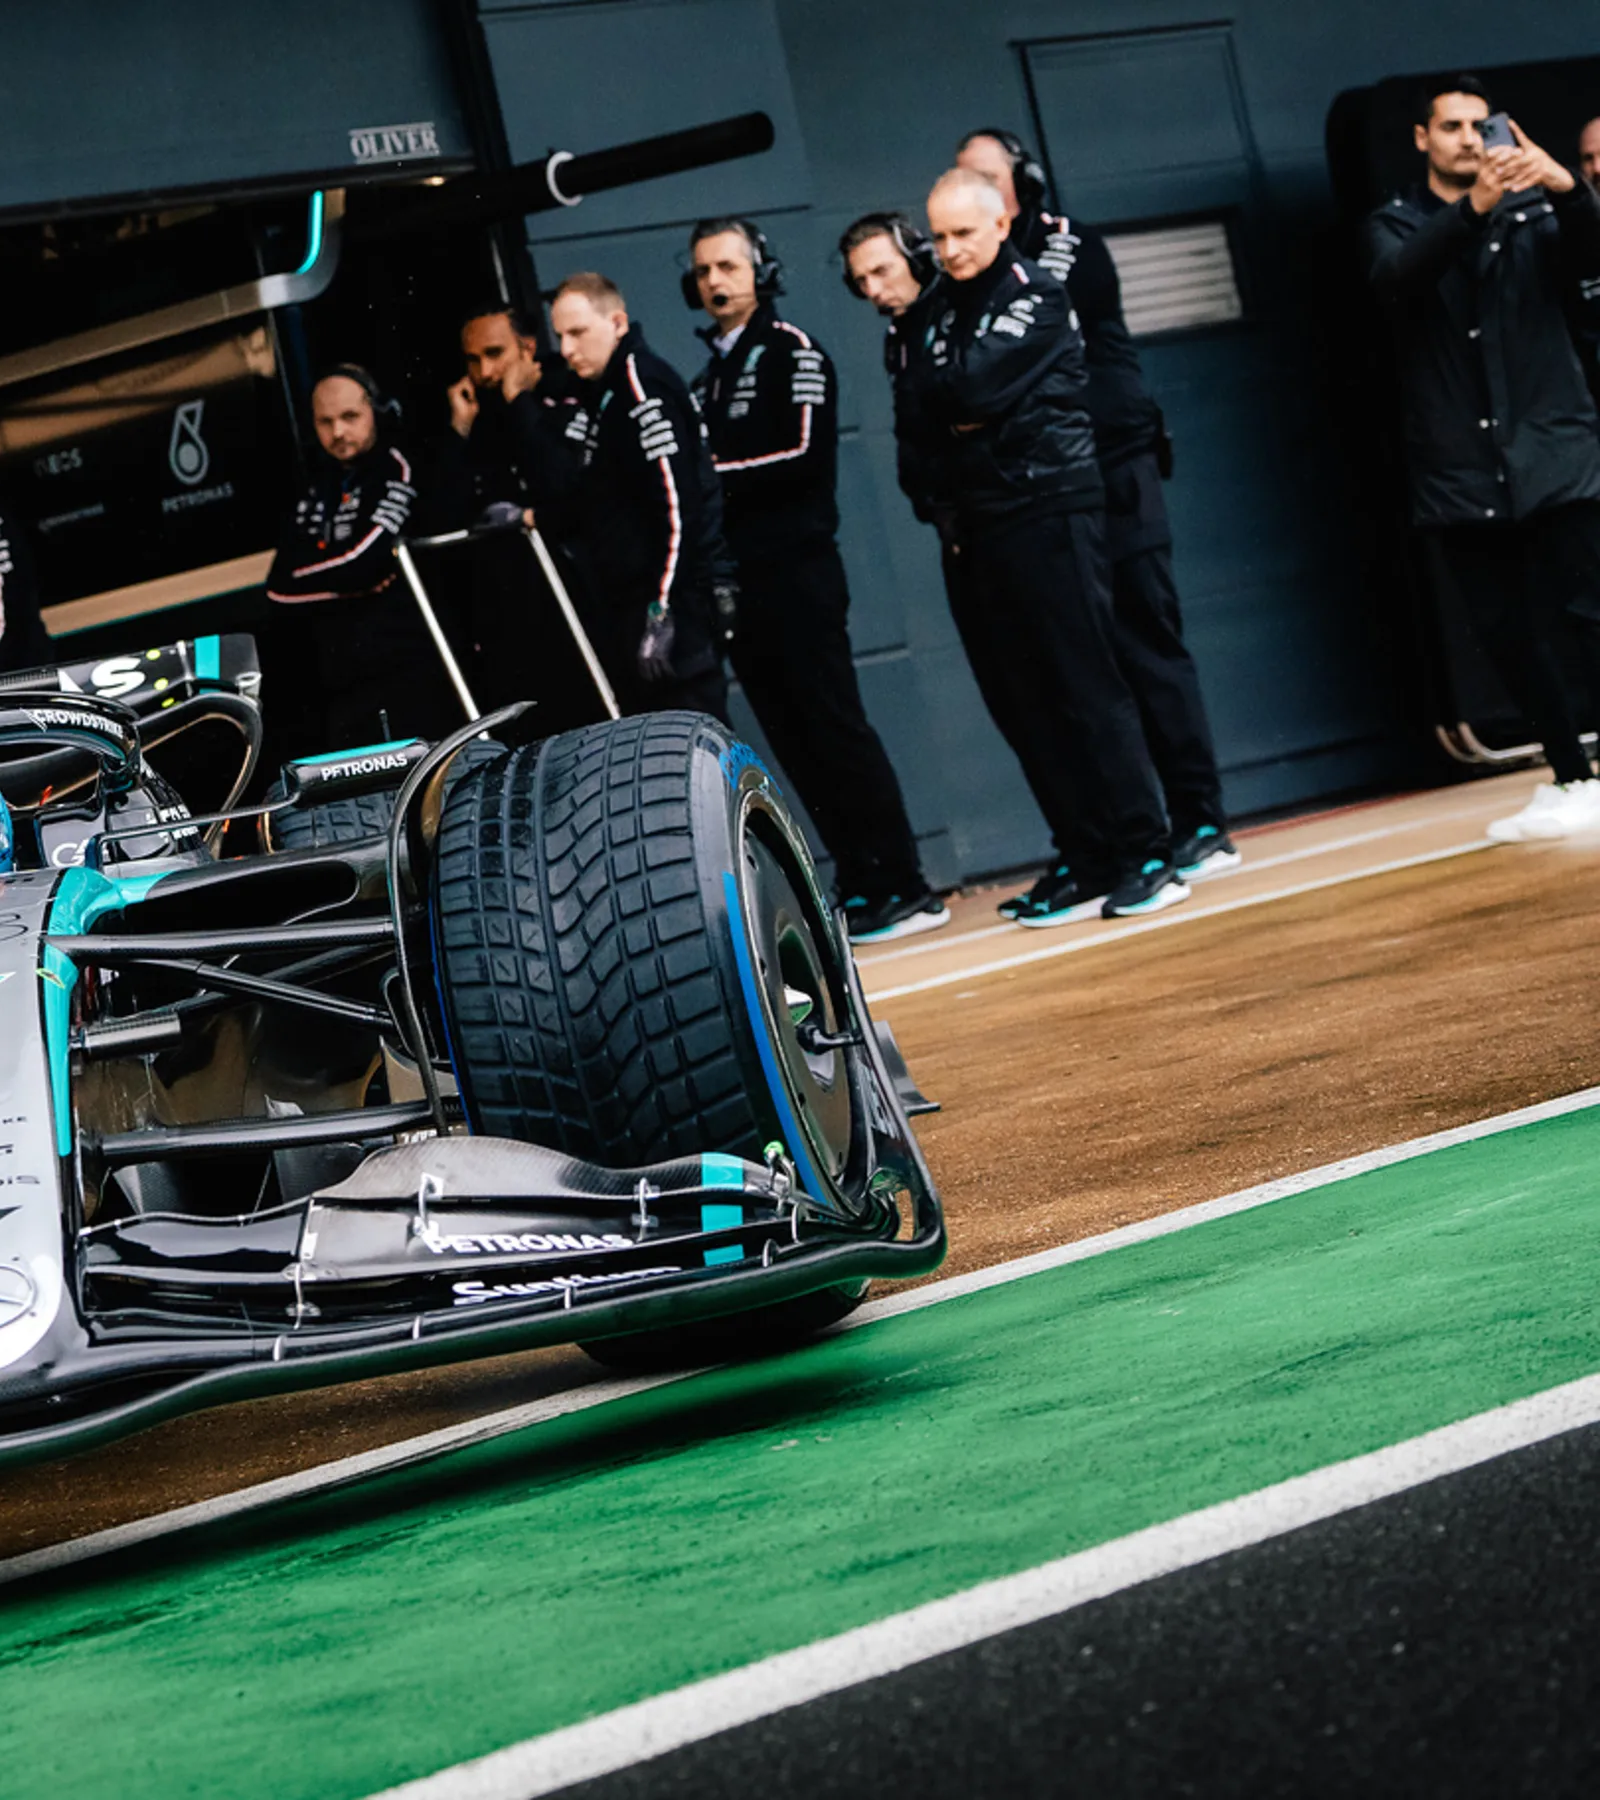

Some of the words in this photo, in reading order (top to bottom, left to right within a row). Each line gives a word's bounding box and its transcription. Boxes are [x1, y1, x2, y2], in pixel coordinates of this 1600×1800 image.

[349, 124, 441, 162] OLIVER
[161, 481, 234, 514] PETRONAS
[320, 753, 408, 781] PETRONAS
[419, 1233, 634, 1254] PETRONAS
